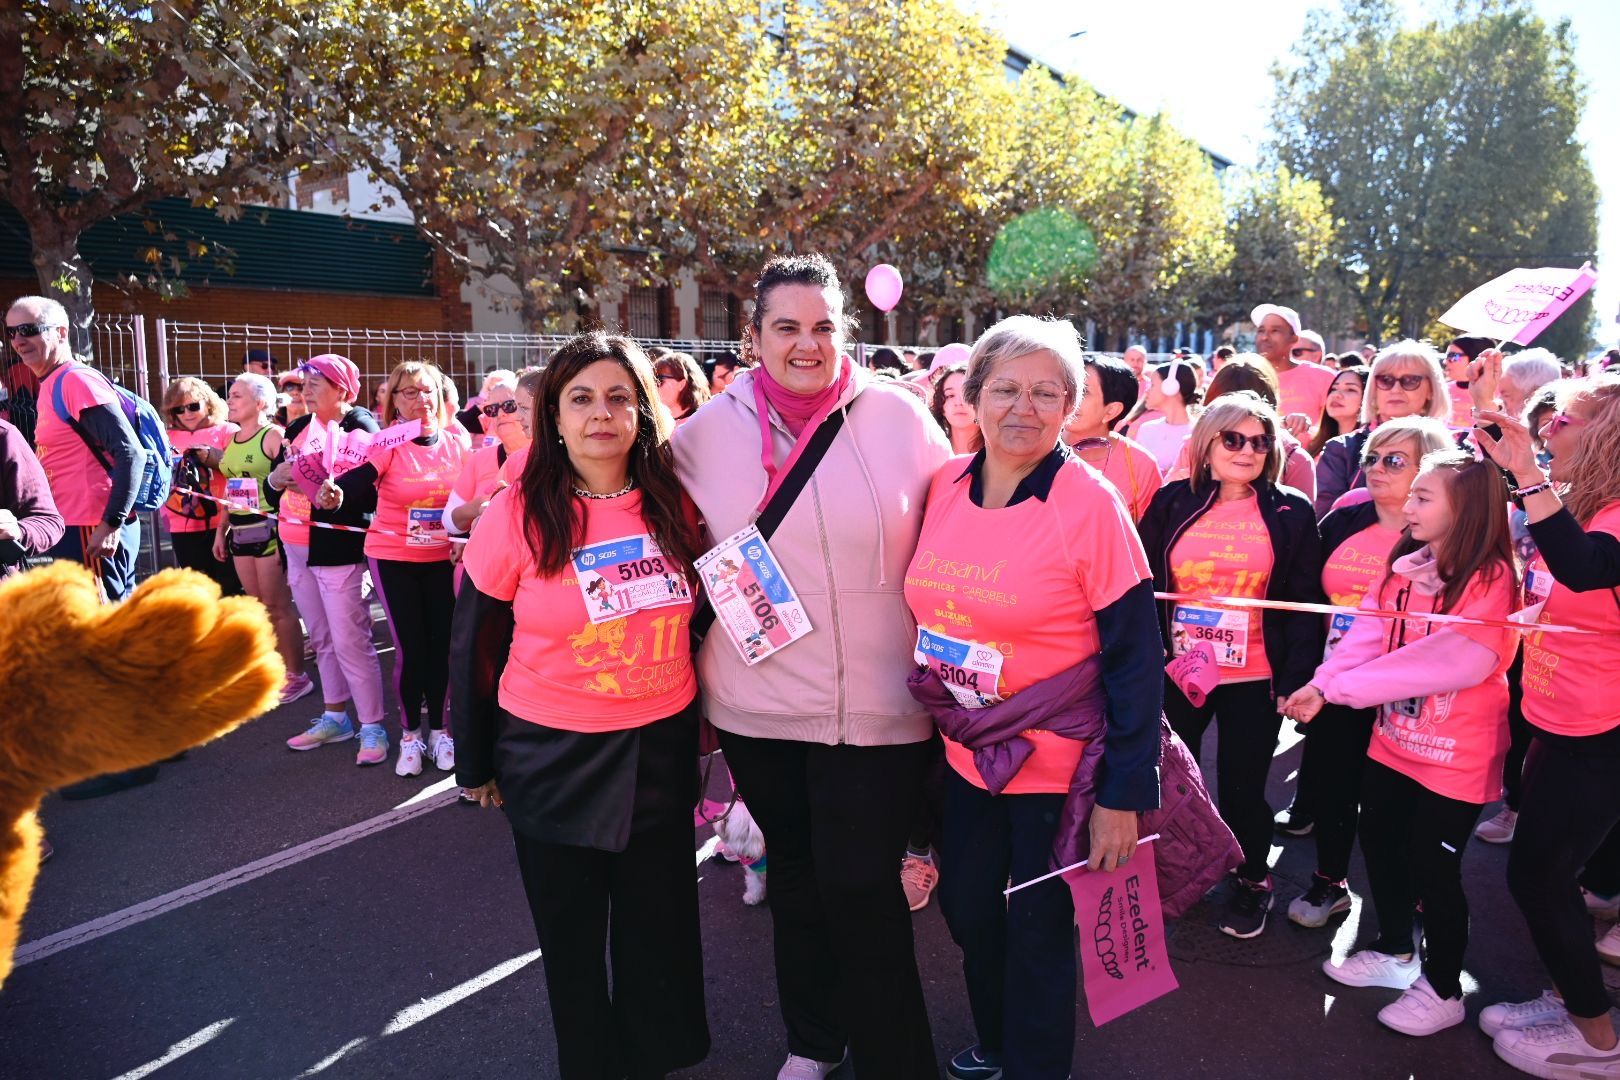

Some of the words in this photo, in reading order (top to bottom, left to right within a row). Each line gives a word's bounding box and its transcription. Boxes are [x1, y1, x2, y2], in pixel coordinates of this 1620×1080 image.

[338, 445, 368, 463] dent
[618, 558, 665, 580] 5103
[743, 582, 779, 630] 5106
[962, 585, 1017, 605] CAROBELS
[934, 608, 972, 623] SUZUKI
[1196, 627, 1234, 642] 3645
[627, 656, 688, 683] Carrera
[940, 663, 979, 690] 5104
[1400, 740, 1455, 763] DRASANVI
[1408, 731, 1457, 750] MUJER
[1117, 896, 1125, 920] Smile
[1125, 874, 1150, 972] Ezedent
[1120, 922, 1129, 963] Designers
